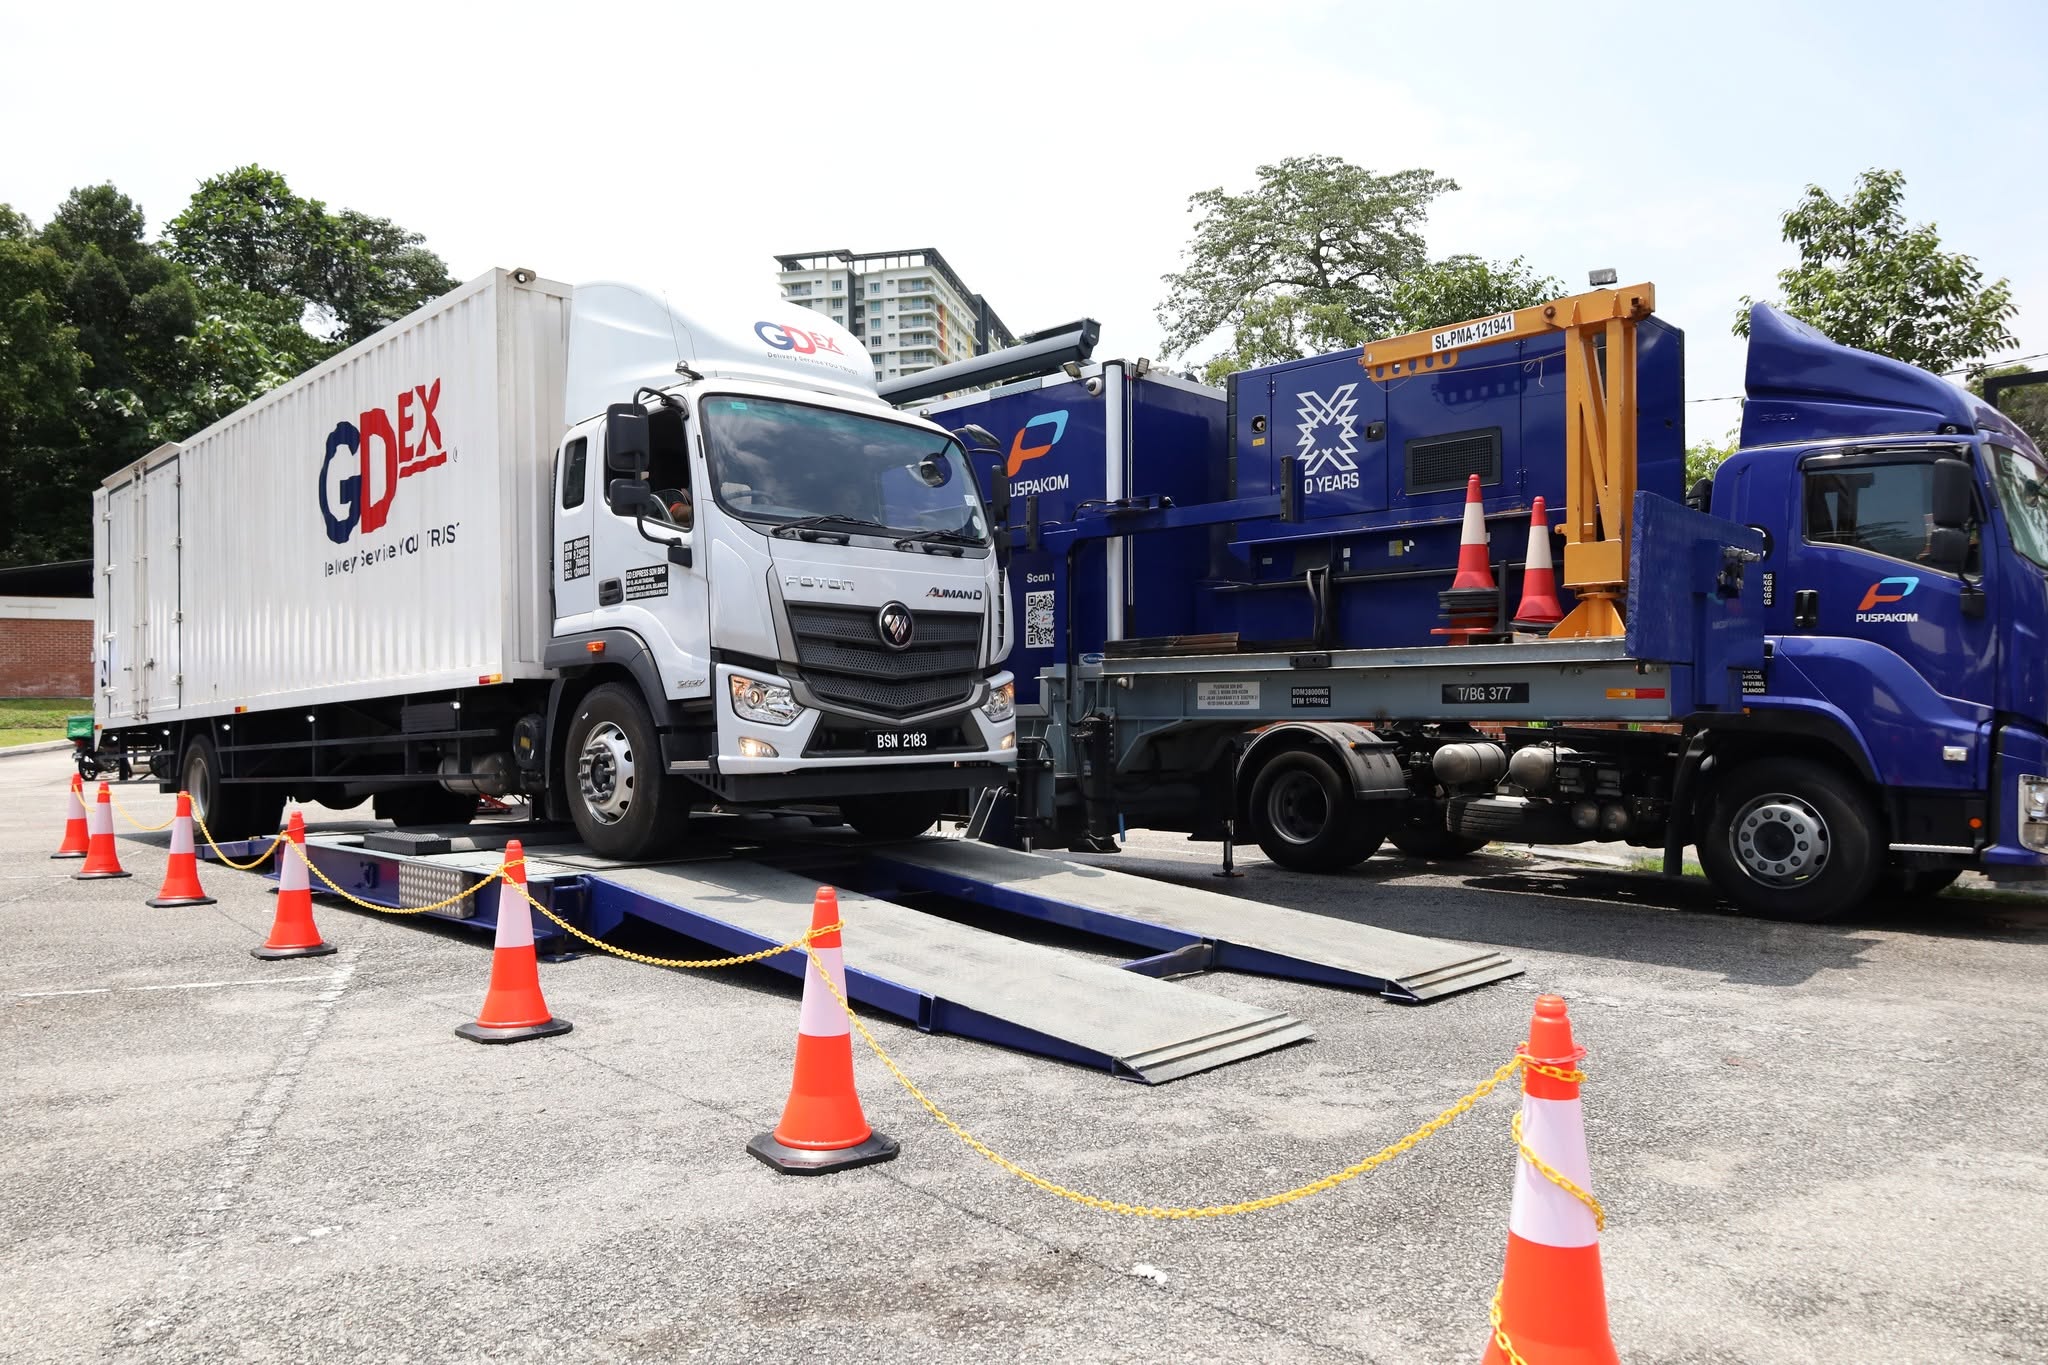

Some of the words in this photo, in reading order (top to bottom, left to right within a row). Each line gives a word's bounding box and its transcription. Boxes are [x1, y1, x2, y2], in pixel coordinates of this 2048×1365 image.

[754, 321, 842, 354] GDEX
[1435, 316, 1512, 350] SL-PMA-121941
[318, 377, 443, 545] GDEX
[1009, 473, 1069, 497] USPAKOM
[1316, 472, 1359, 493] YEARS
[785, 575, 854, 591] FOTON
[1026, 573, 1050, 583] Scan
[1855, 613, 1918, 623] PUSPAKOM
[1458, 687, 1485, 701] T/BG
[1489, 687, 1512, 700] 377
[877, 733, 898, 749] BSN
[903, 733, 927, 747] 2183
